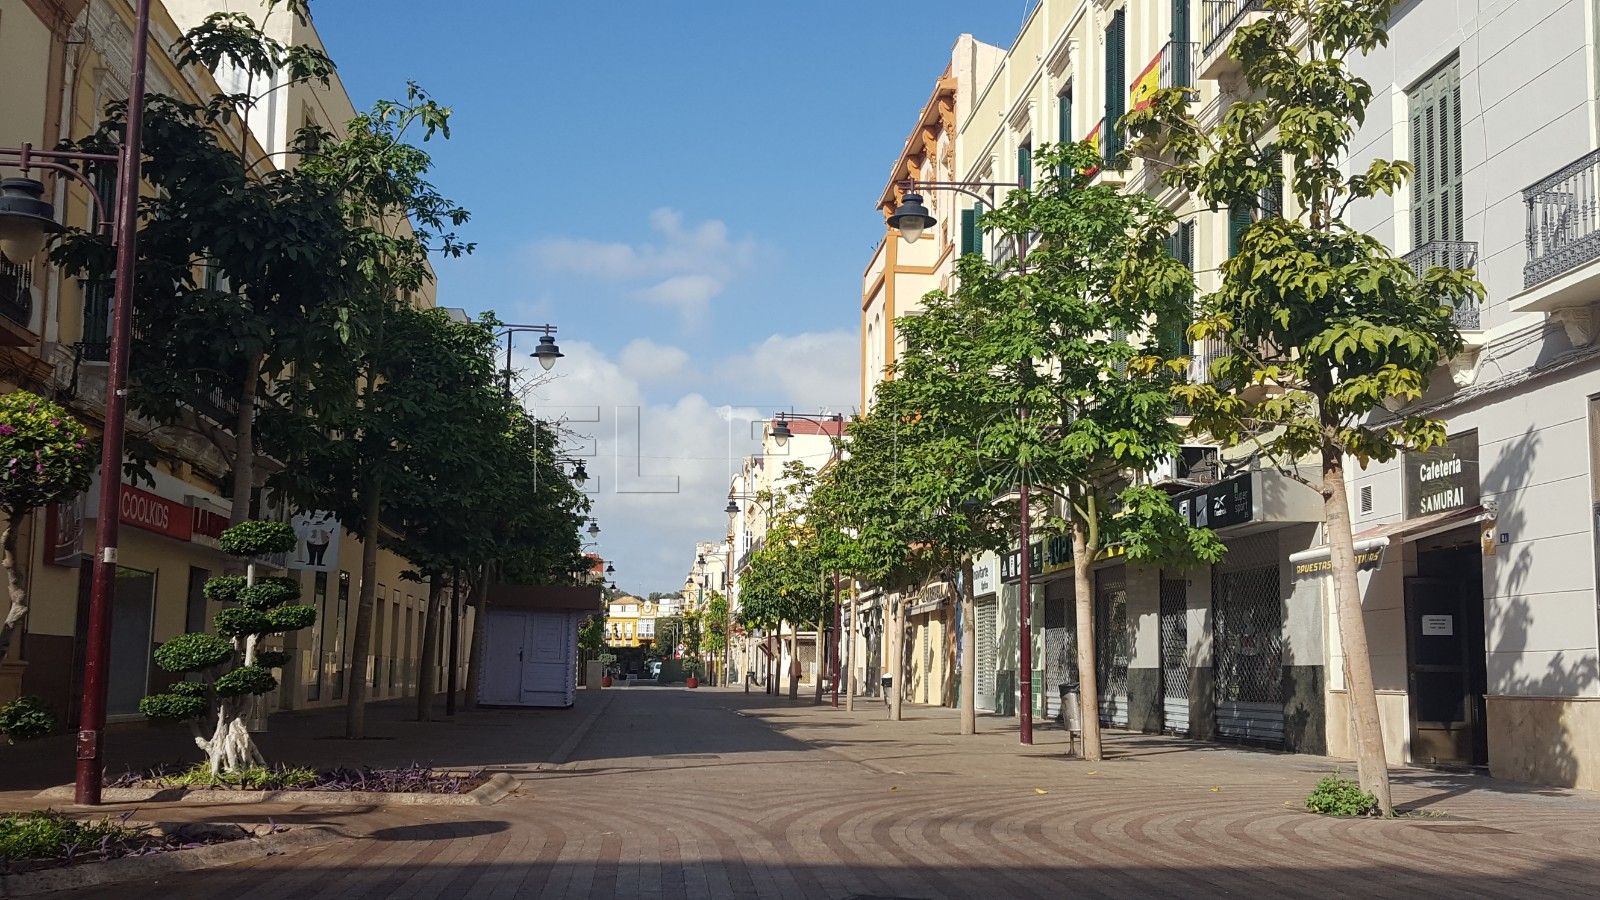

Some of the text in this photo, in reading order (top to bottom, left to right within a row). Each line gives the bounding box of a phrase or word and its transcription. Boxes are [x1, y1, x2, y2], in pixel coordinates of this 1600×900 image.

[1420, 453, 1462, 482] Cafetería
[121, 491, 169, 529] COOLKIDS
[1420, 486, 1464, 514] SAMURAI
